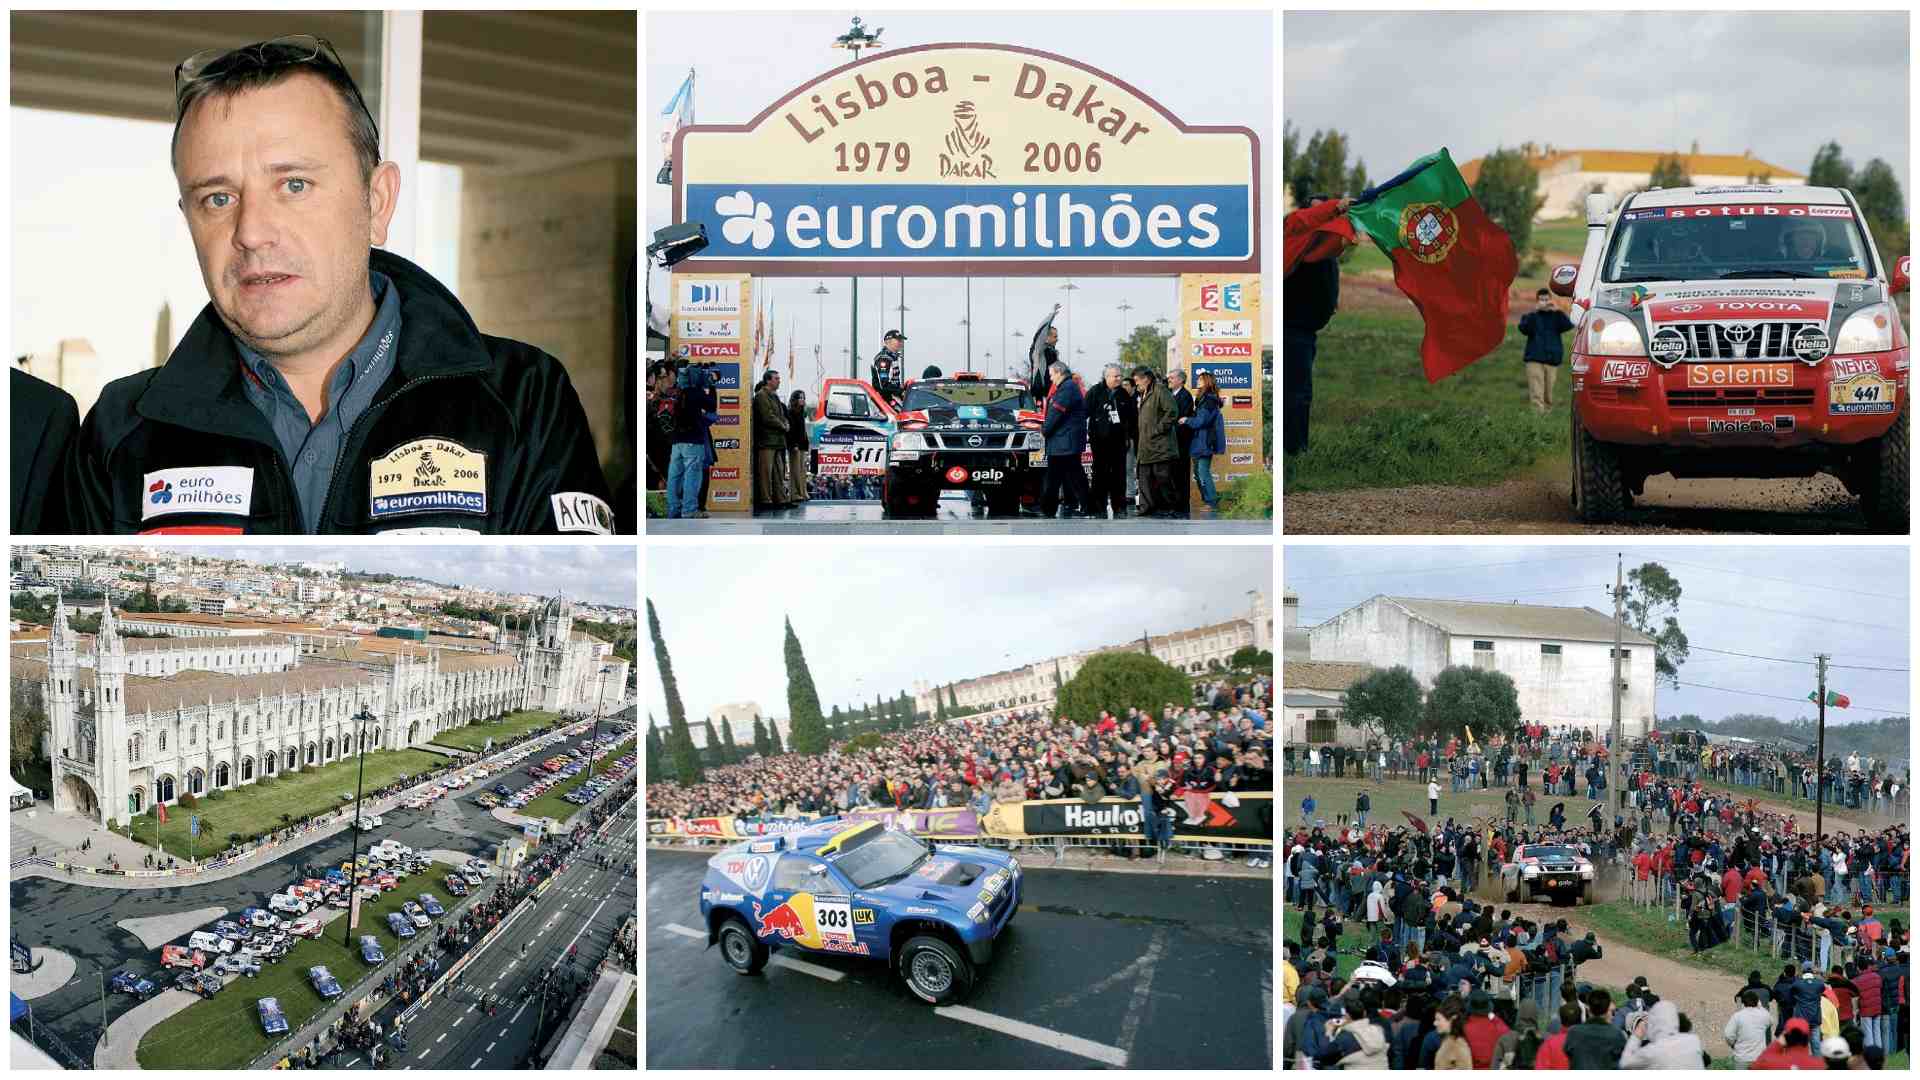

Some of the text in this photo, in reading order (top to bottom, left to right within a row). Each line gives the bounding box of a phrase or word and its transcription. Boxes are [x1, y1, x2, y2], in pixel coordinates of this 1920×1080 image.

[785, 66, 948, 144] Lisboa
[1014, 63, 1149, 148] Dakar
[834, 142, 1102, 172] 1979 2006
[939, 153, 998, 180] DAKAR
[786, 191, 1221, 249] euromilhões
[1718, 302, 1803, 311] TOYOTA
[692, 344, 738, 355] TOTAL
[1206, 344, 1250, 354] TOTAL
[1652, 340, 1683, 351] Hella
[1797, 338, 1827, 349] Hella
[1603, 361, 1648, 379] NEVES
[1693, 364, 1788, 384] Selenis
[1833, 359, 1879, 378] NEVES
[1855, 386, 1879, 401] 441
[389, 445, 423, 463] Lisboa
[436, 442, 466, 459] Dakar
[821, 455, 849, 463] TOTAL
[180, 477, 214, 488] euro
[378, 469, 479, 484] 1979 2006
[972, 469, 1004, 481] galp
[178, 490, 242, 504] milhões
[389, 491, 482, 509] euromilhões
[559, 497, 610, 530] ACTIO
[818, 909, 848, 928] 303
